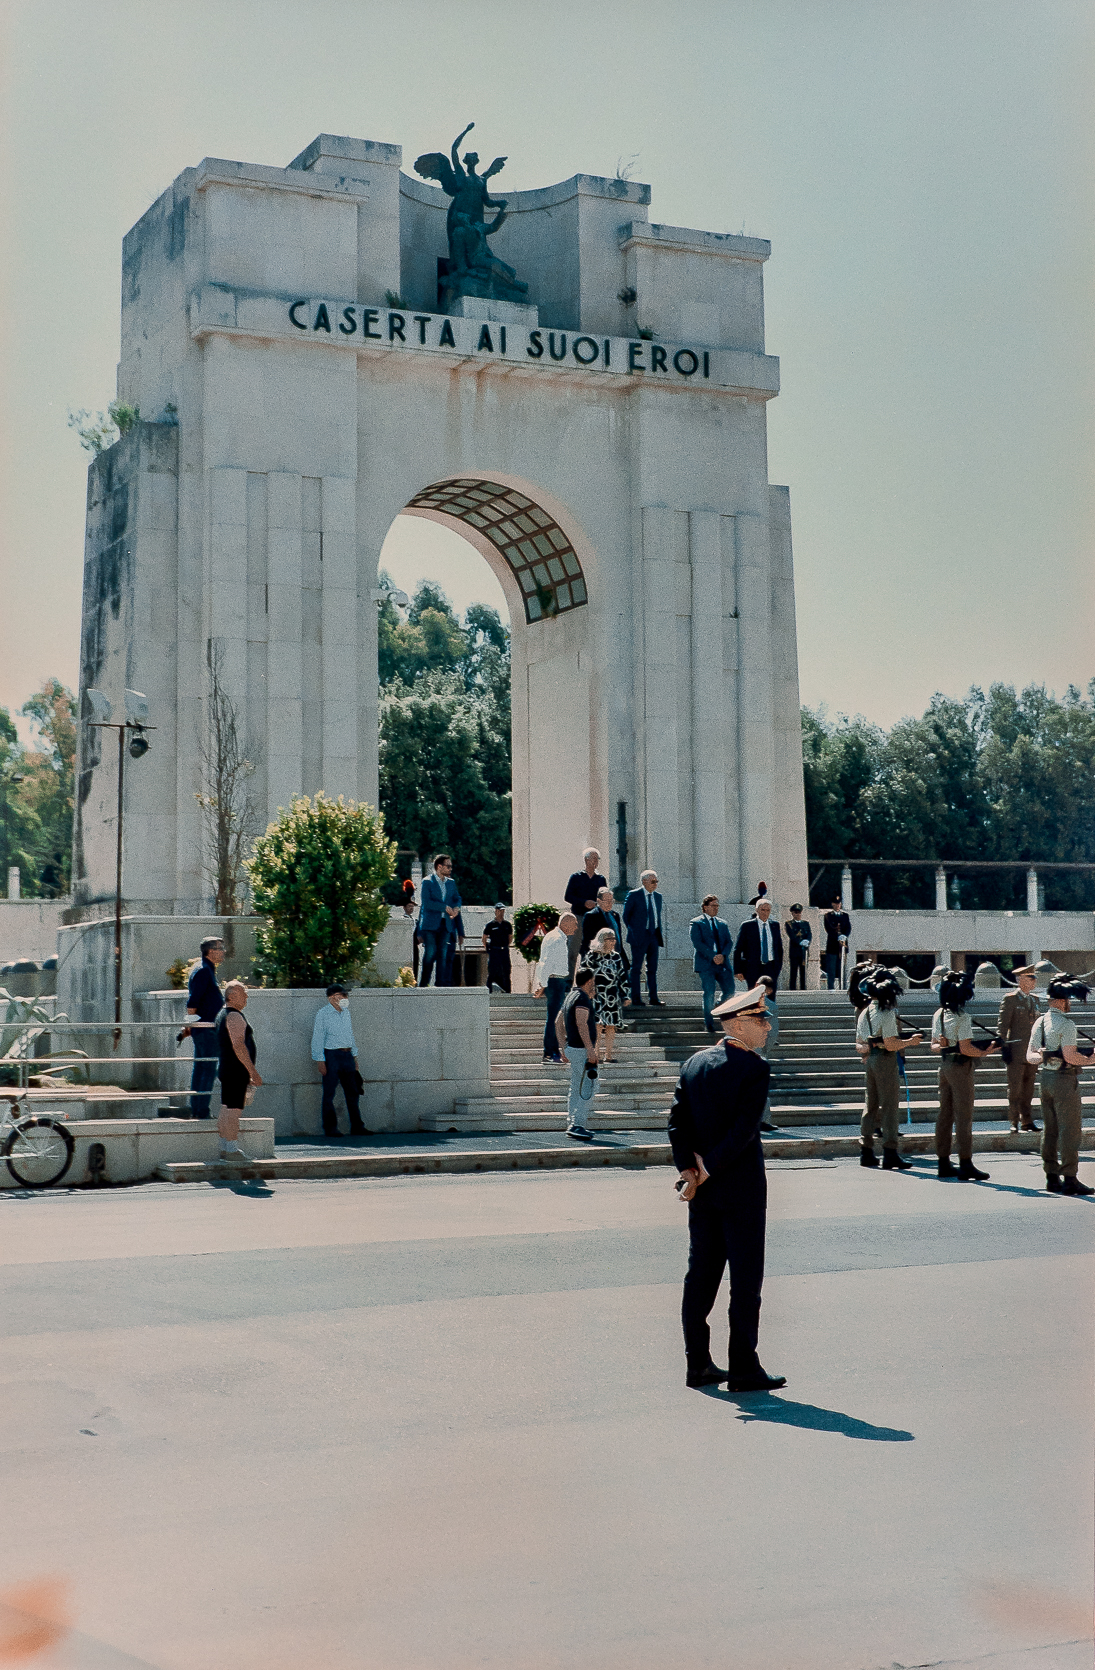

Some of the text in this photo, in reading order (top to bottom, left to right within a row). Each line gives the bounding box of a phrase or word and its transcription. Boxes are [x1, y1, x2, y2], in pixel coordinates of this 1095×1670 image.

[288, 300, 710, 378] CASERTA AI SUOI EROI
